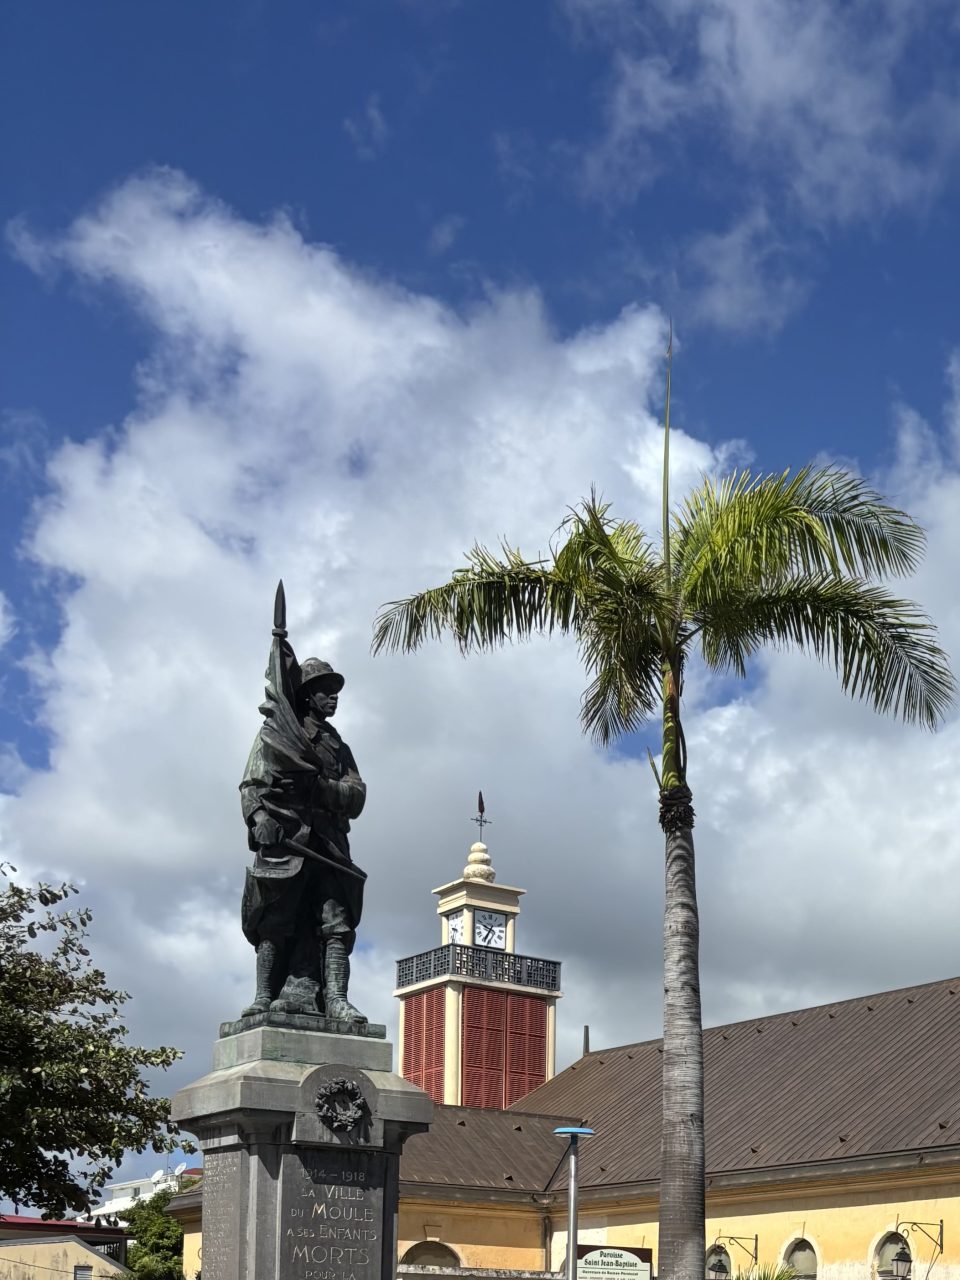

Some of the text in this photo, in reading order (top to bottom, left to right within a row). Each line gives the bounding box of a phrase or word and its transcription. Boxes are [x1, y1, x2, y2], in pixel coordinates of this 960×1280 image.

[342, 1170, 365, 1182] 1918
[290, 1202, 374, 1222] DU MOULE
[297, 1228, 315, 1238] SES
[319, 1224, 377, 1241] ENFANTS
[291, 1244, 370, 1265] MORTS
[600, 1250, 623, 1258] Paroisse
[584, 1258, 599, 1267] Saint
[305, 1270, 356, 1280] POUR LA
